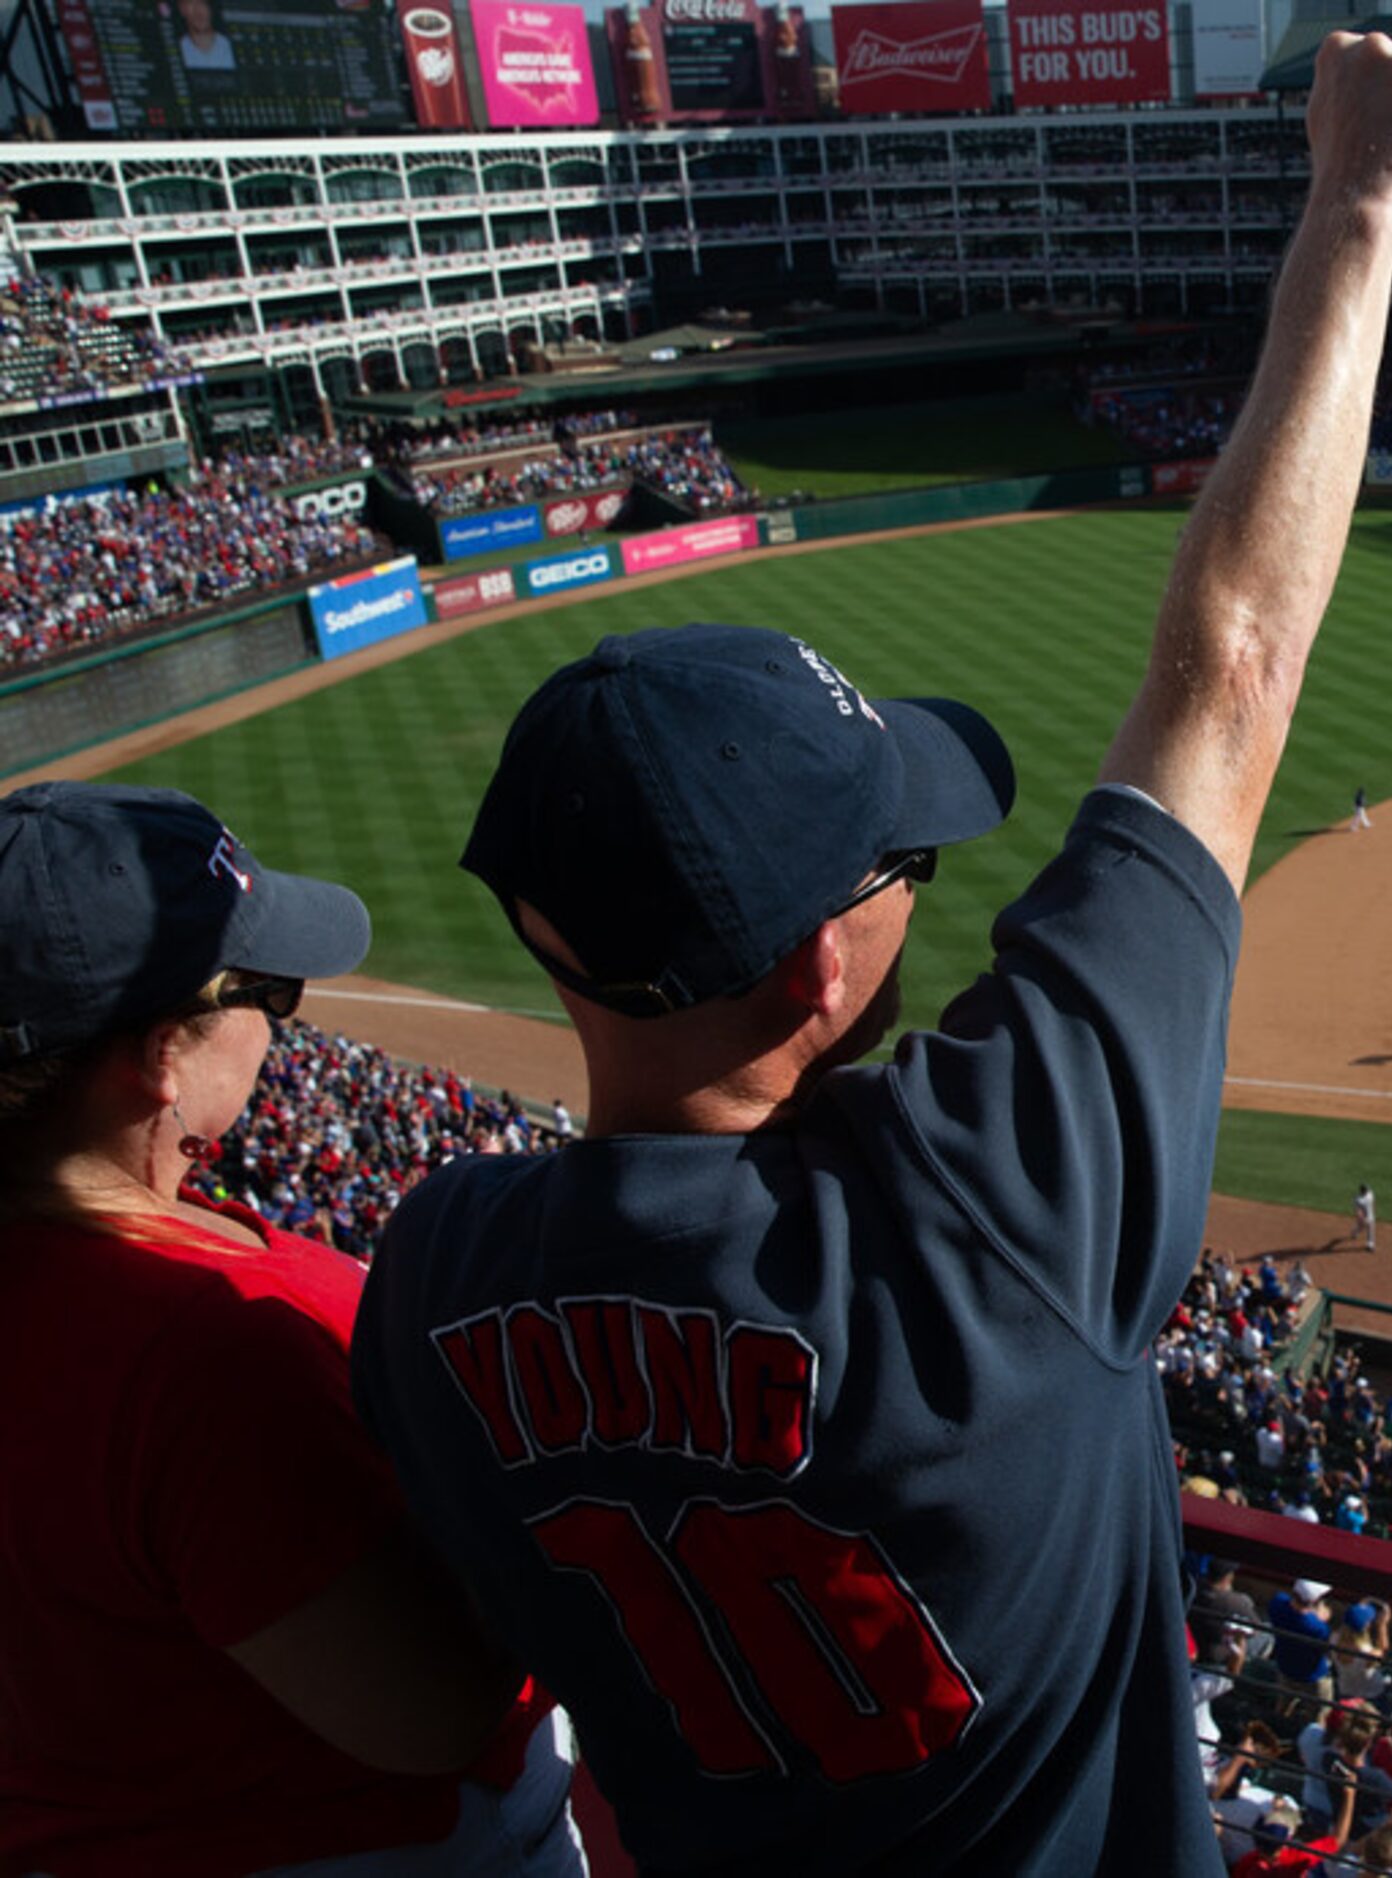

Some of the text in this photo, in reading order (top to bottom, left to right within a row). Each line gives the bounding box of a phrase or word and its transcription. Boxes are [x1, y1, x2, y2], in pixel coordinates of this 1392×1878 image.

[1017, 16, 1074, 46] THIS
[1081, 9, 1162, 43] BUD'S
[853, 41, 969, 71] Budweiser
[1019, 47, 1137, 82] FOR YOU.
[528, 553, 610, 589] GEICO
[323, 590, 406, 634] Southwest
[428, 1294, 819, 1484] YOUNG
[522, 1494, 985, 1788] 10
